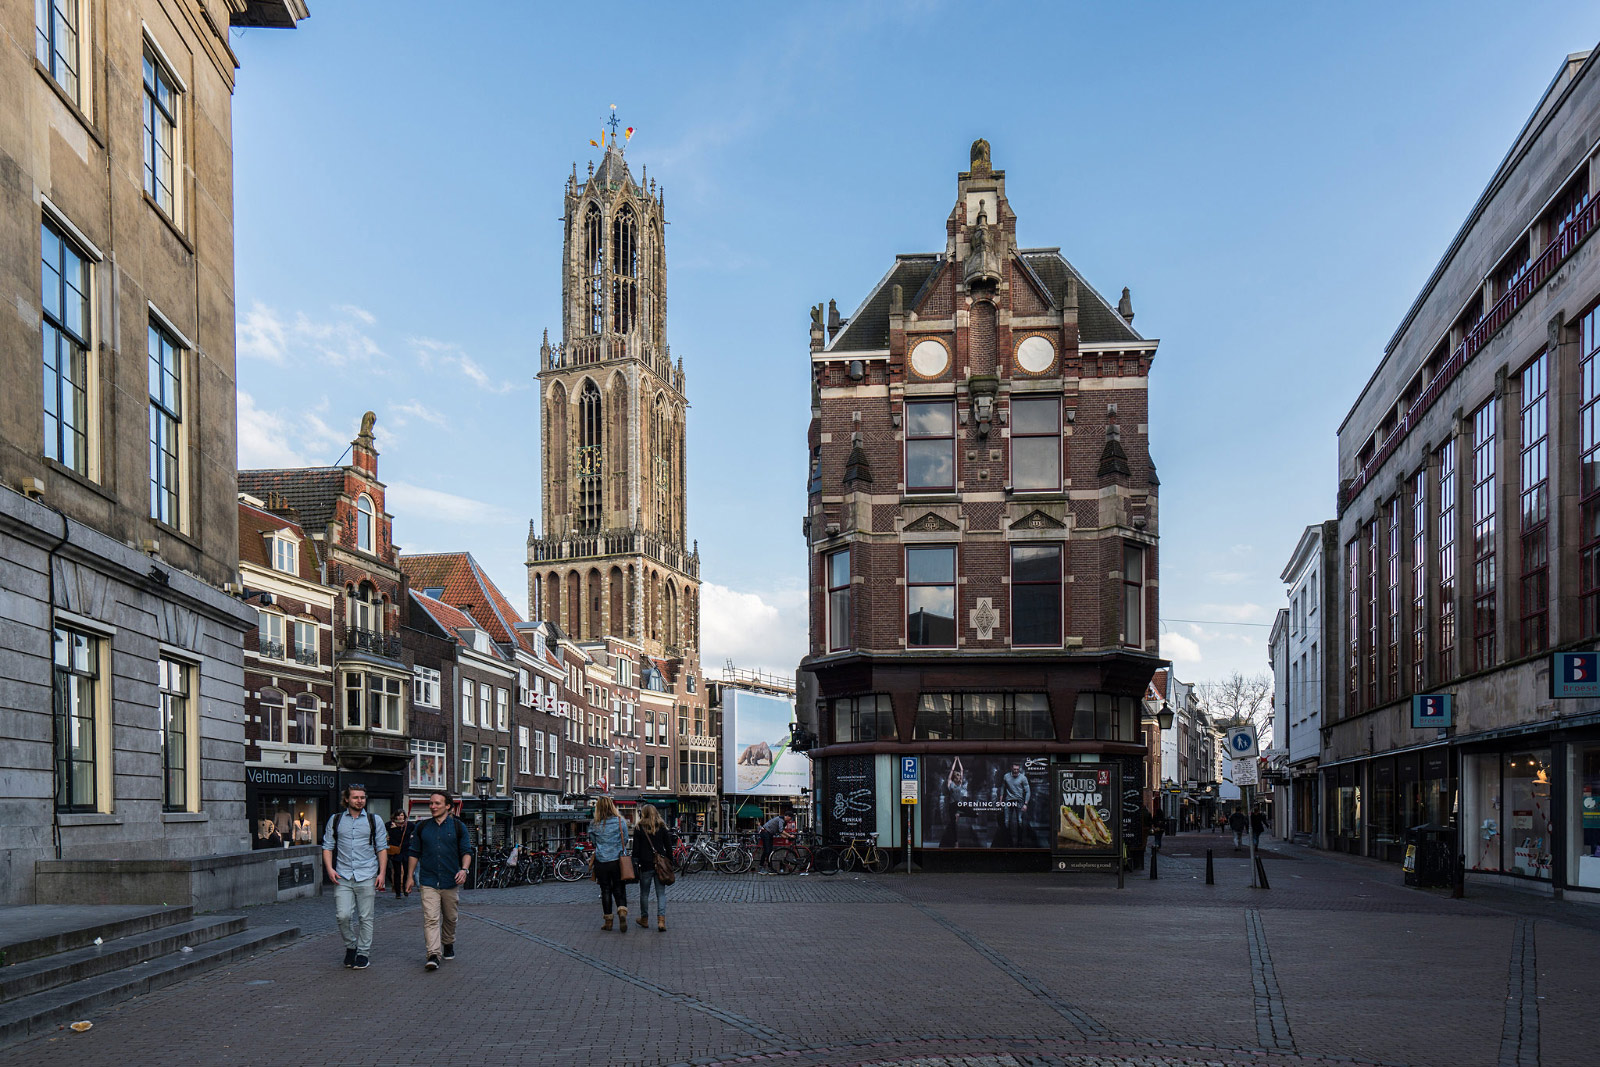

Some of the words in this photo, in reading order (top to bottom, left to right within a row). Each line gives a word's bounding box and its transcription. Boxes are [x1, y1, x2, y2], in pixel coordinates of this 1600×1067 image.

[905, 759, 914, 772] P
[248, 769, 293, 784] Veltman
[297, 772, 335, 788] Liesting
[1062, 779, 1096, 792] CLUB
[1062, 793, 1102, 806] WRAP
